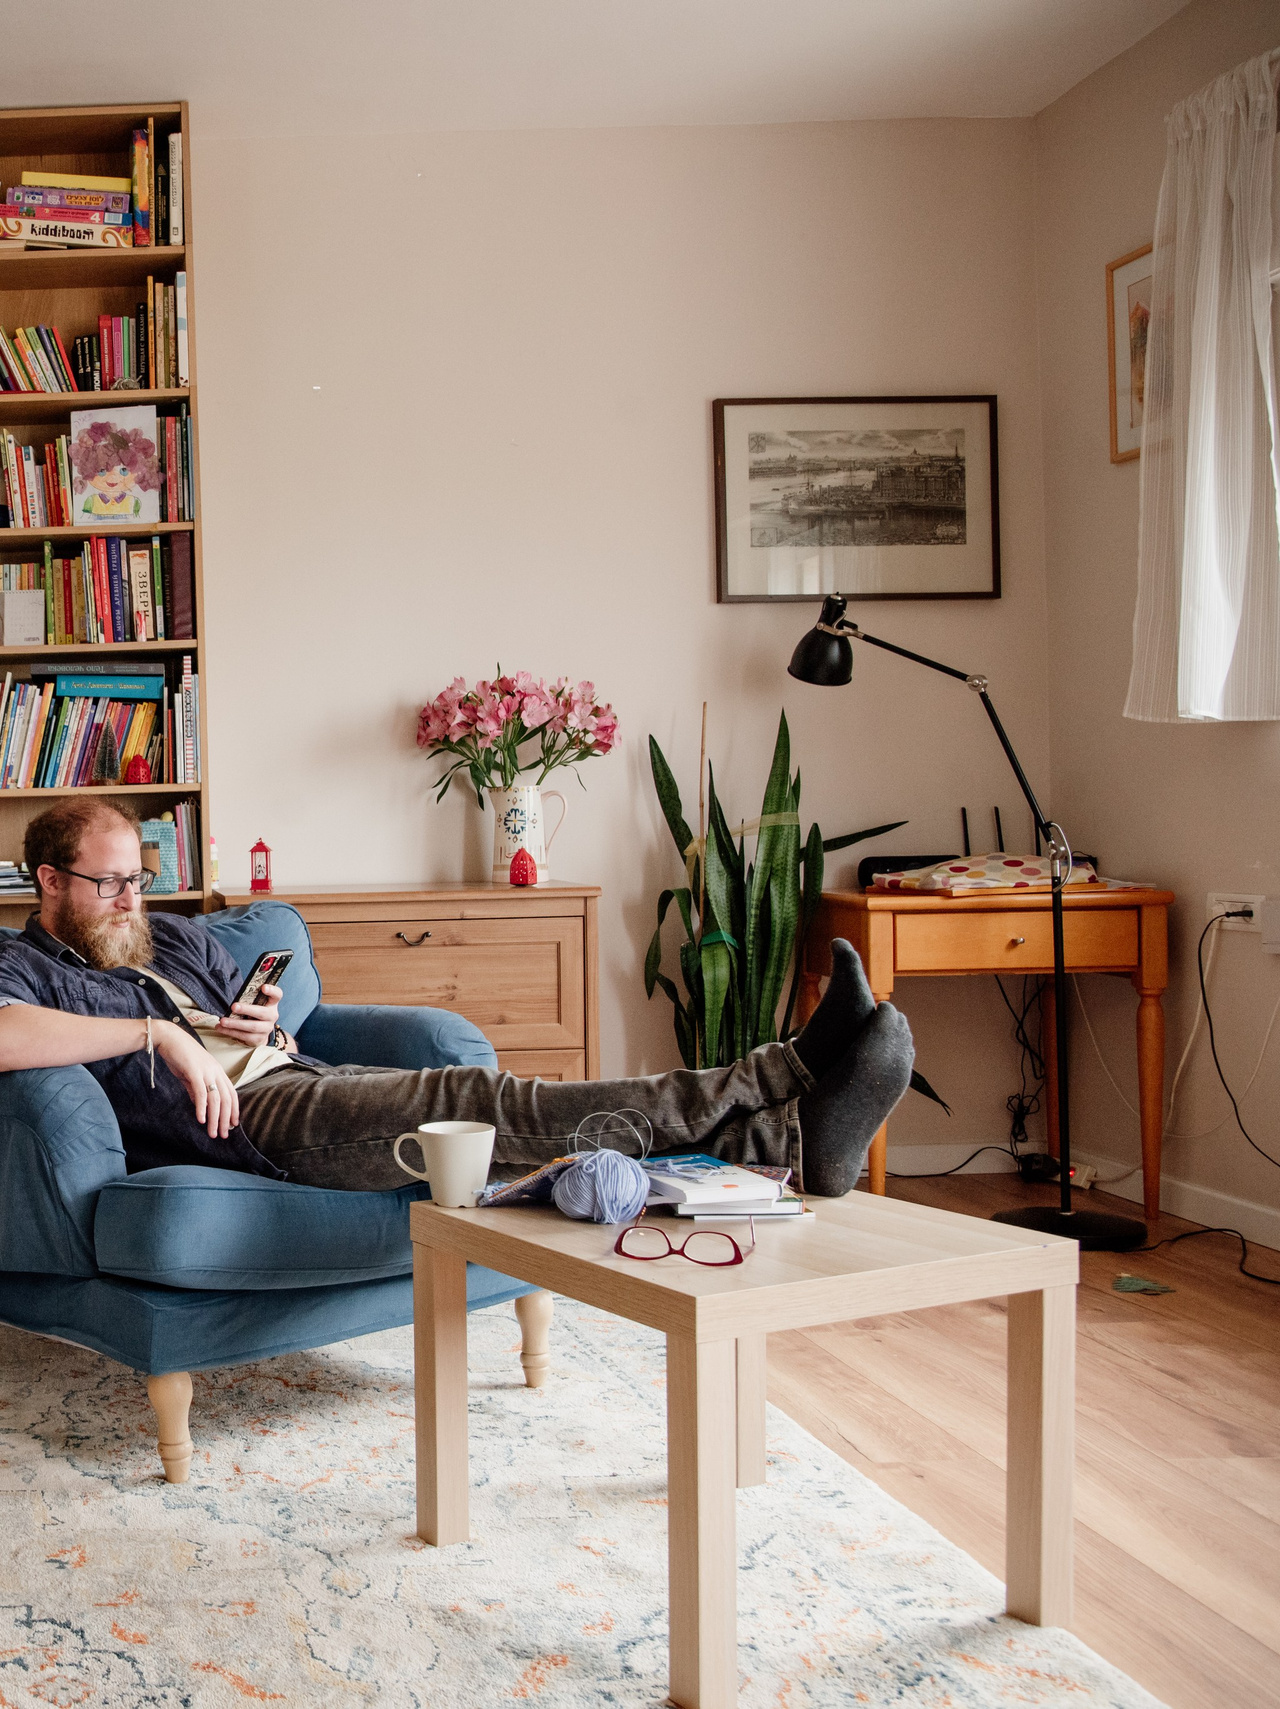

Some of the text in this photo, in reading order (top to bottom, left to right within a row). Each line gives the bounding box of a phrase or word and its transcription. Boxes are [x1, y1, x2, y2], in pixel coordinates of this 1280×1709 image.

[90, 211, 101, 223] 4
[30, 223, 95, 240] kiddiboom
[110, 543, 118, 571] ГРЕЦИИ
[111, 574, 121, 606] ДРЕВНЕЙ
